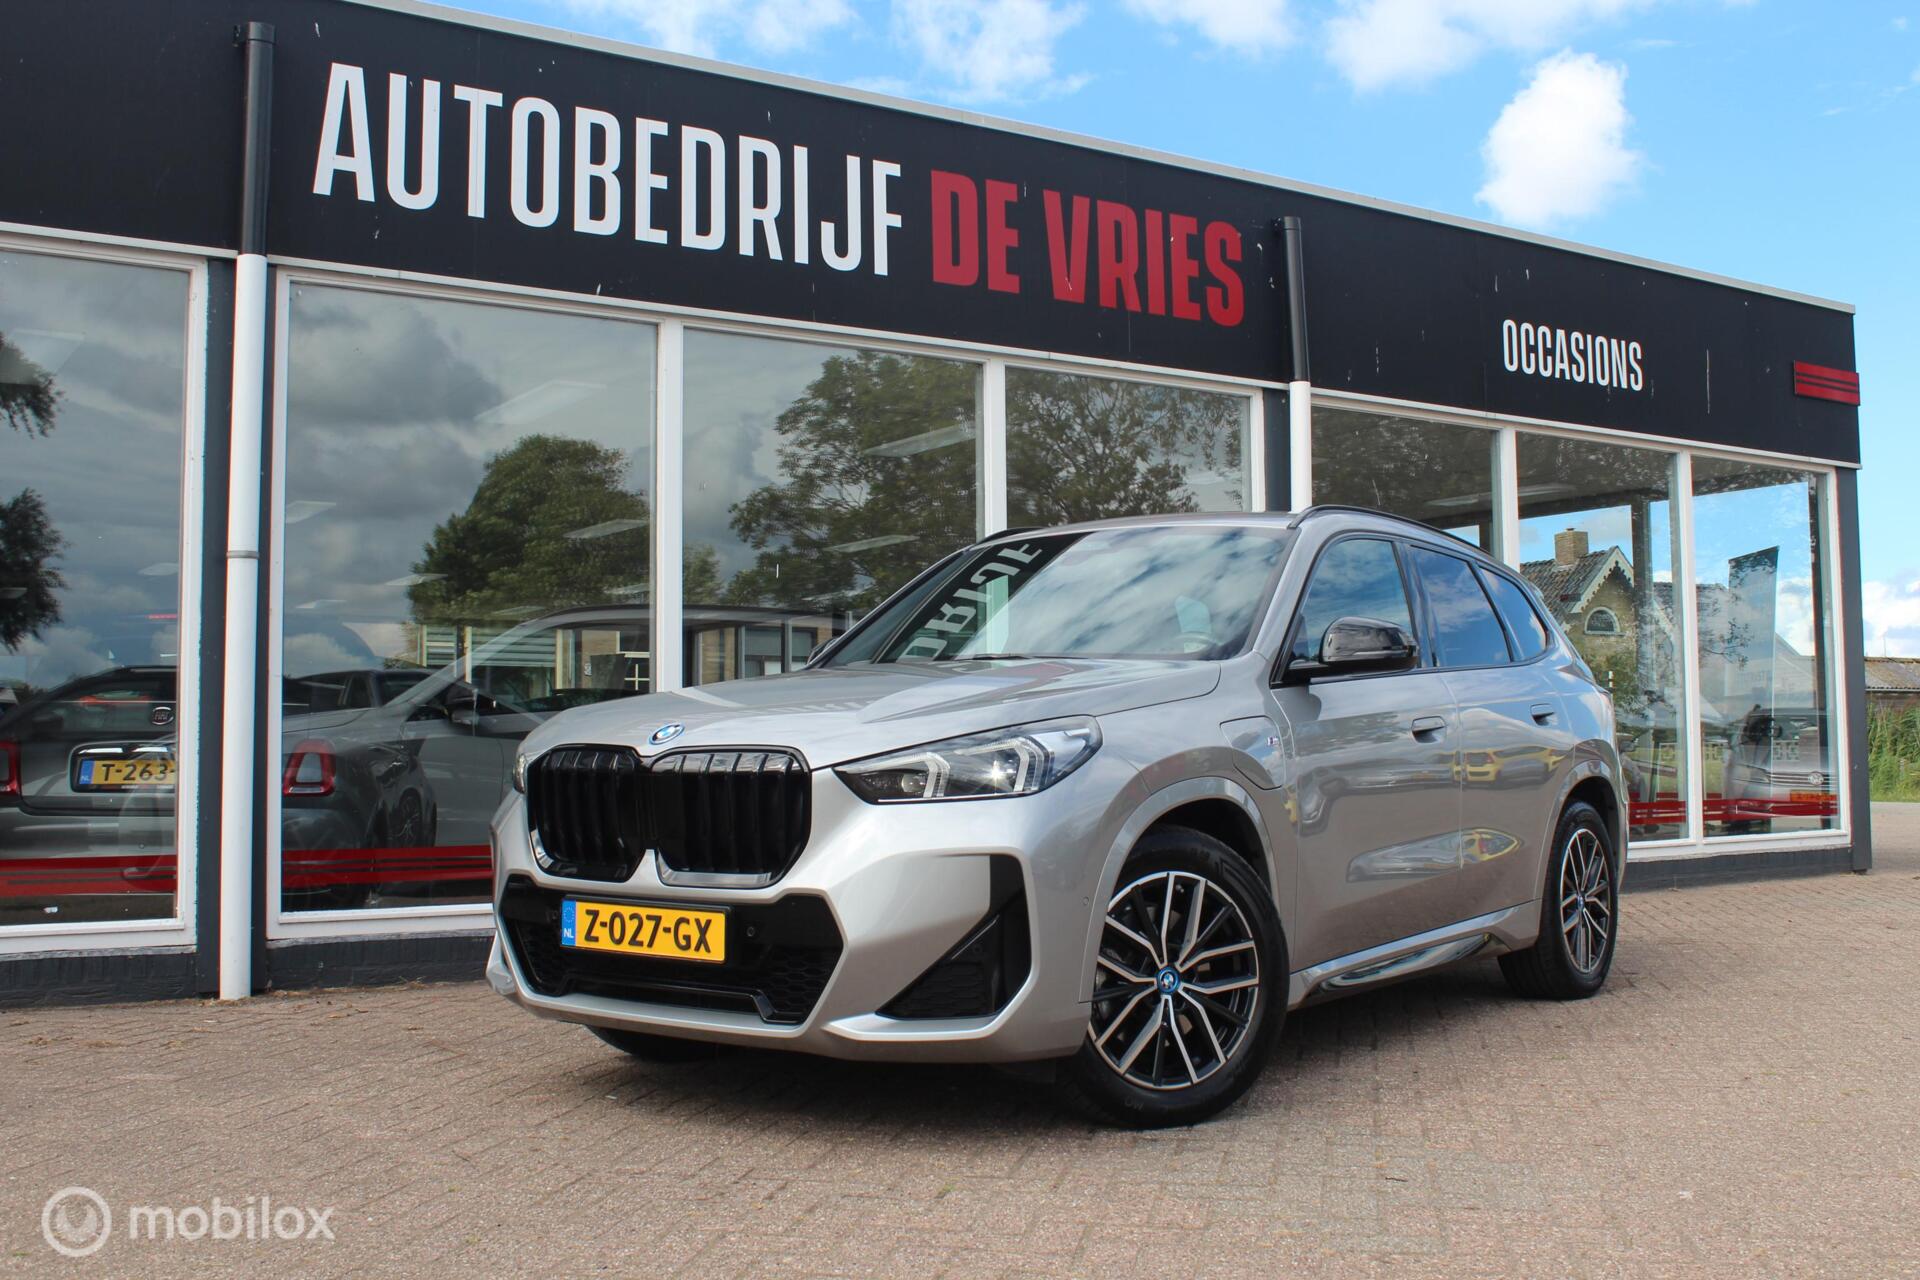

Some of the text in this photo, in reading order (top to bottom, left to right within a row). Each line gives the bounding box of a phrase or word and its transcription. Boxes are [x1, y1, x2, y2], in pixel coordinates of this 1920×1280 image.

[313, 62, 1246, 328] AUTOBEDRIJF DE VRIES
[1502, 318, 1644, 392] OCCASIONS
[563, 909, 712, 953] NL Z-027-GX
